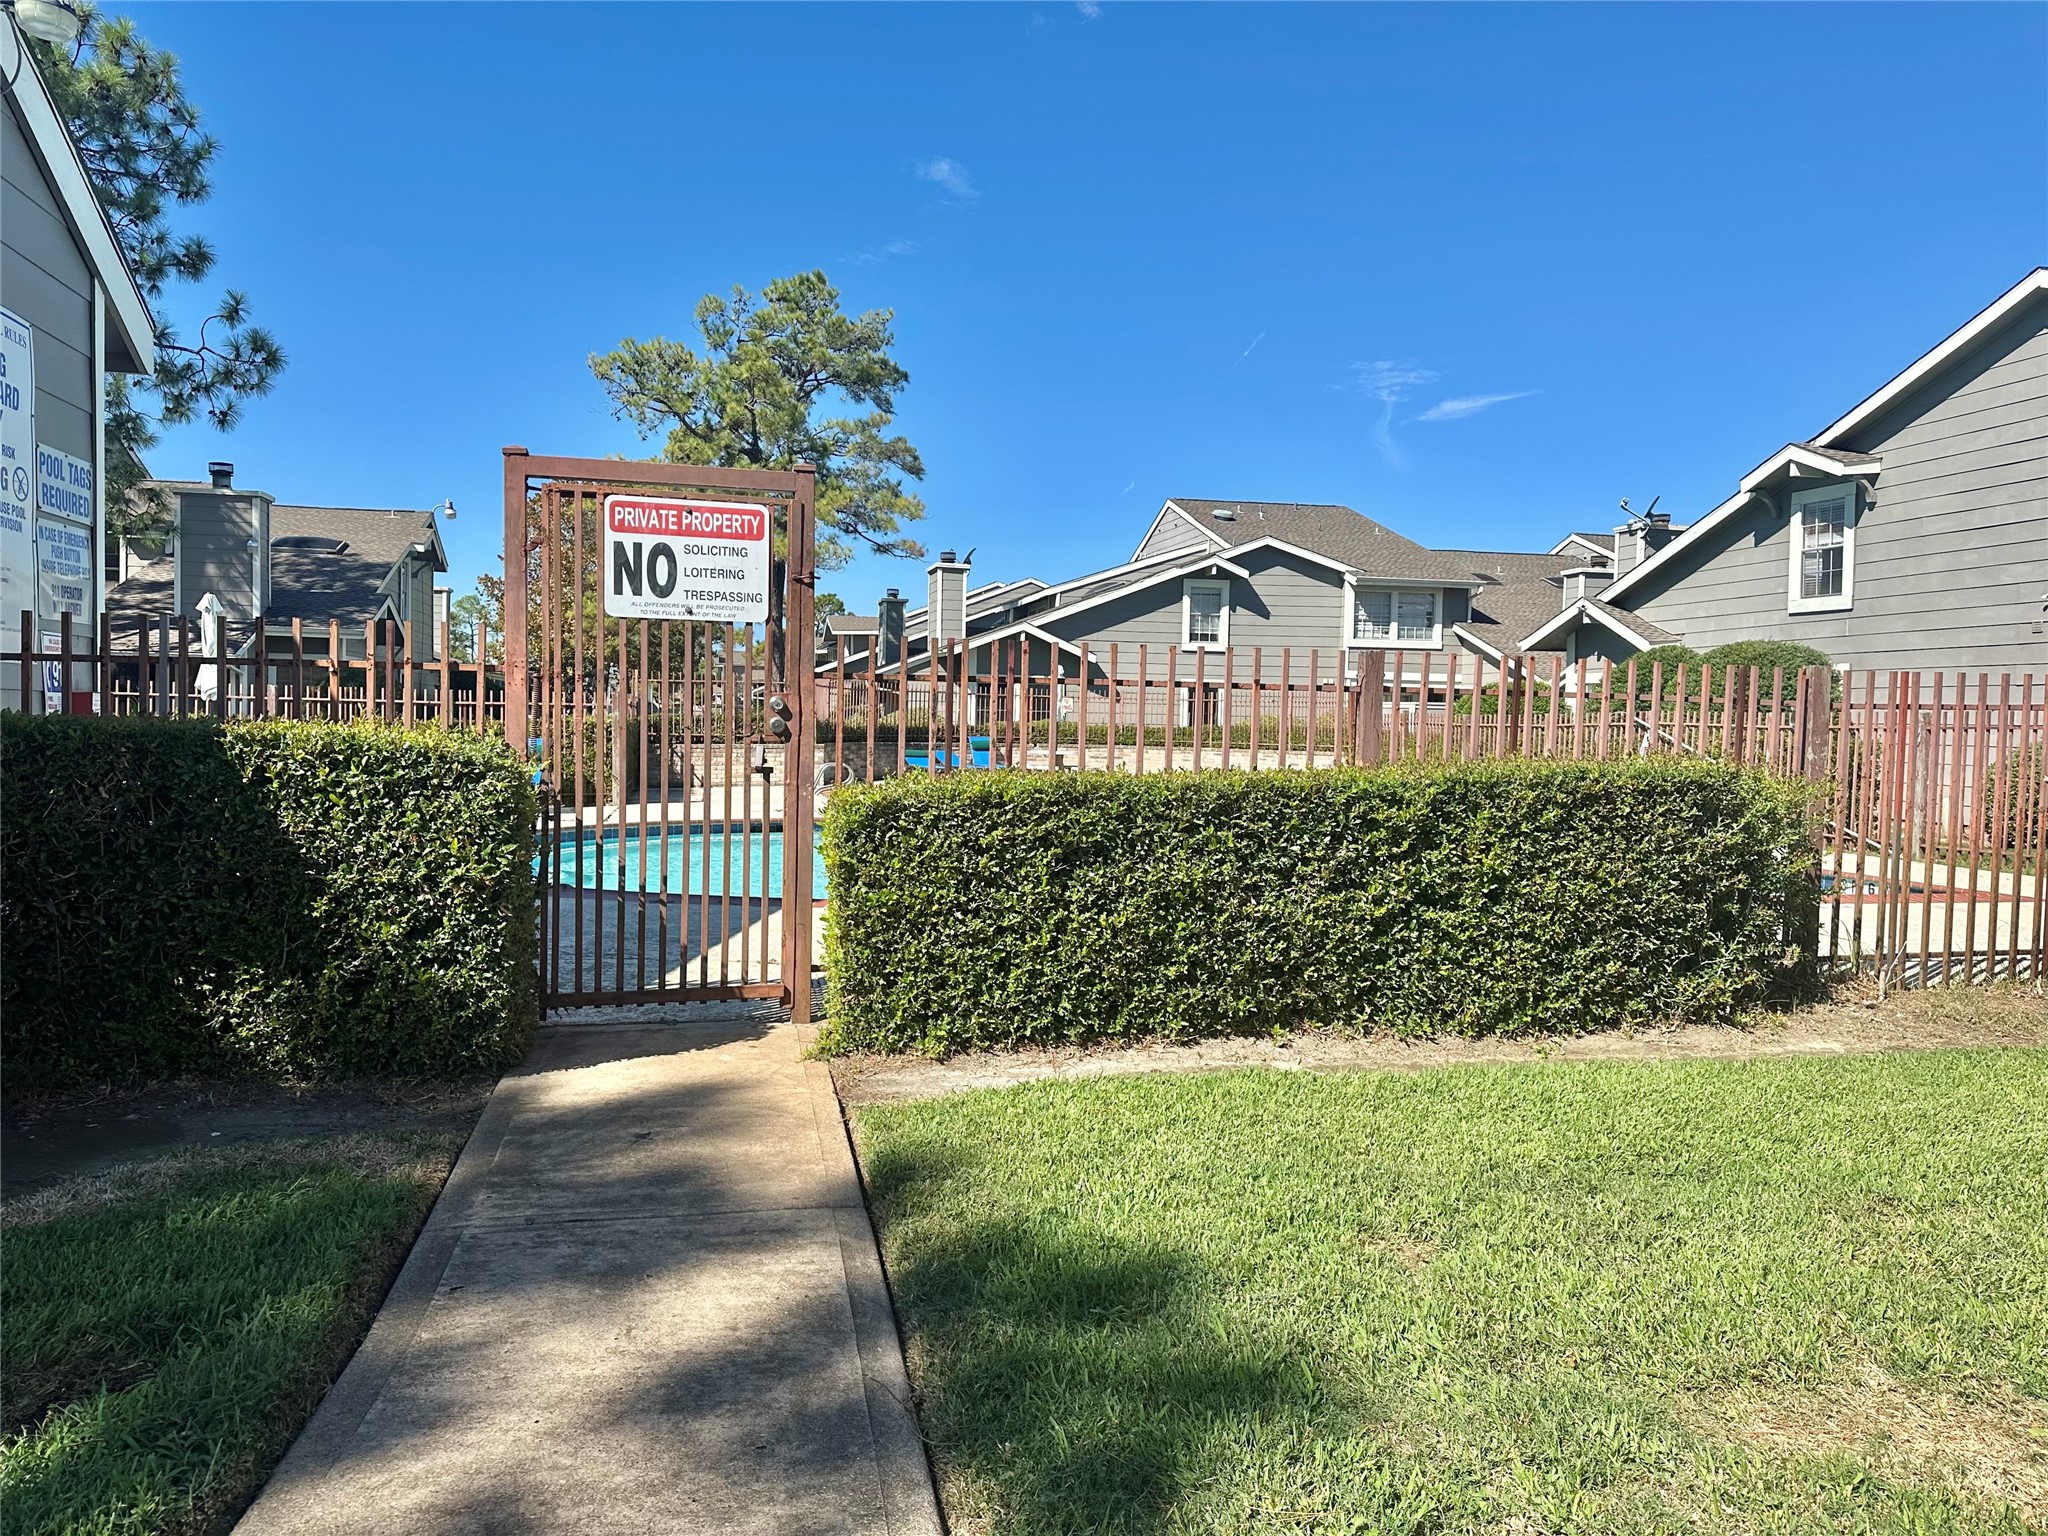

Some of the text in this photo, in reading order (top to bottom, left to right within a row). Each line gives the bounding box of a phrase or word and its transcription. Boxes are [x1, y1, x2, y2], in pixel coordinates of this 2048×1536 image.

[4, 326, 27, 349] RULES
[2, 444, 16, 460] RISK
[40, 451, 91, 491] POOL TAGS
[42, 482, 89, 519] REQUIRED
[12, 504, 26, 520] POOL
[614, 506, 760, 535] PRIVATE PROPERTY
[38, 525, 44, 539] IN
[45, 526, 57, 542] CASE
[57, 530, 63, 544] OF
[51, 544, 81, 563] PUSH BUTTON
[684, 544, 748, 558] SOLICITING
[613, 541, 678, 599] NO
[684, 567, 745, 580] LOITERING
[61, 585, 82, 601] OPERATOR
[684, 590, 763, 604] TRESPASSING
